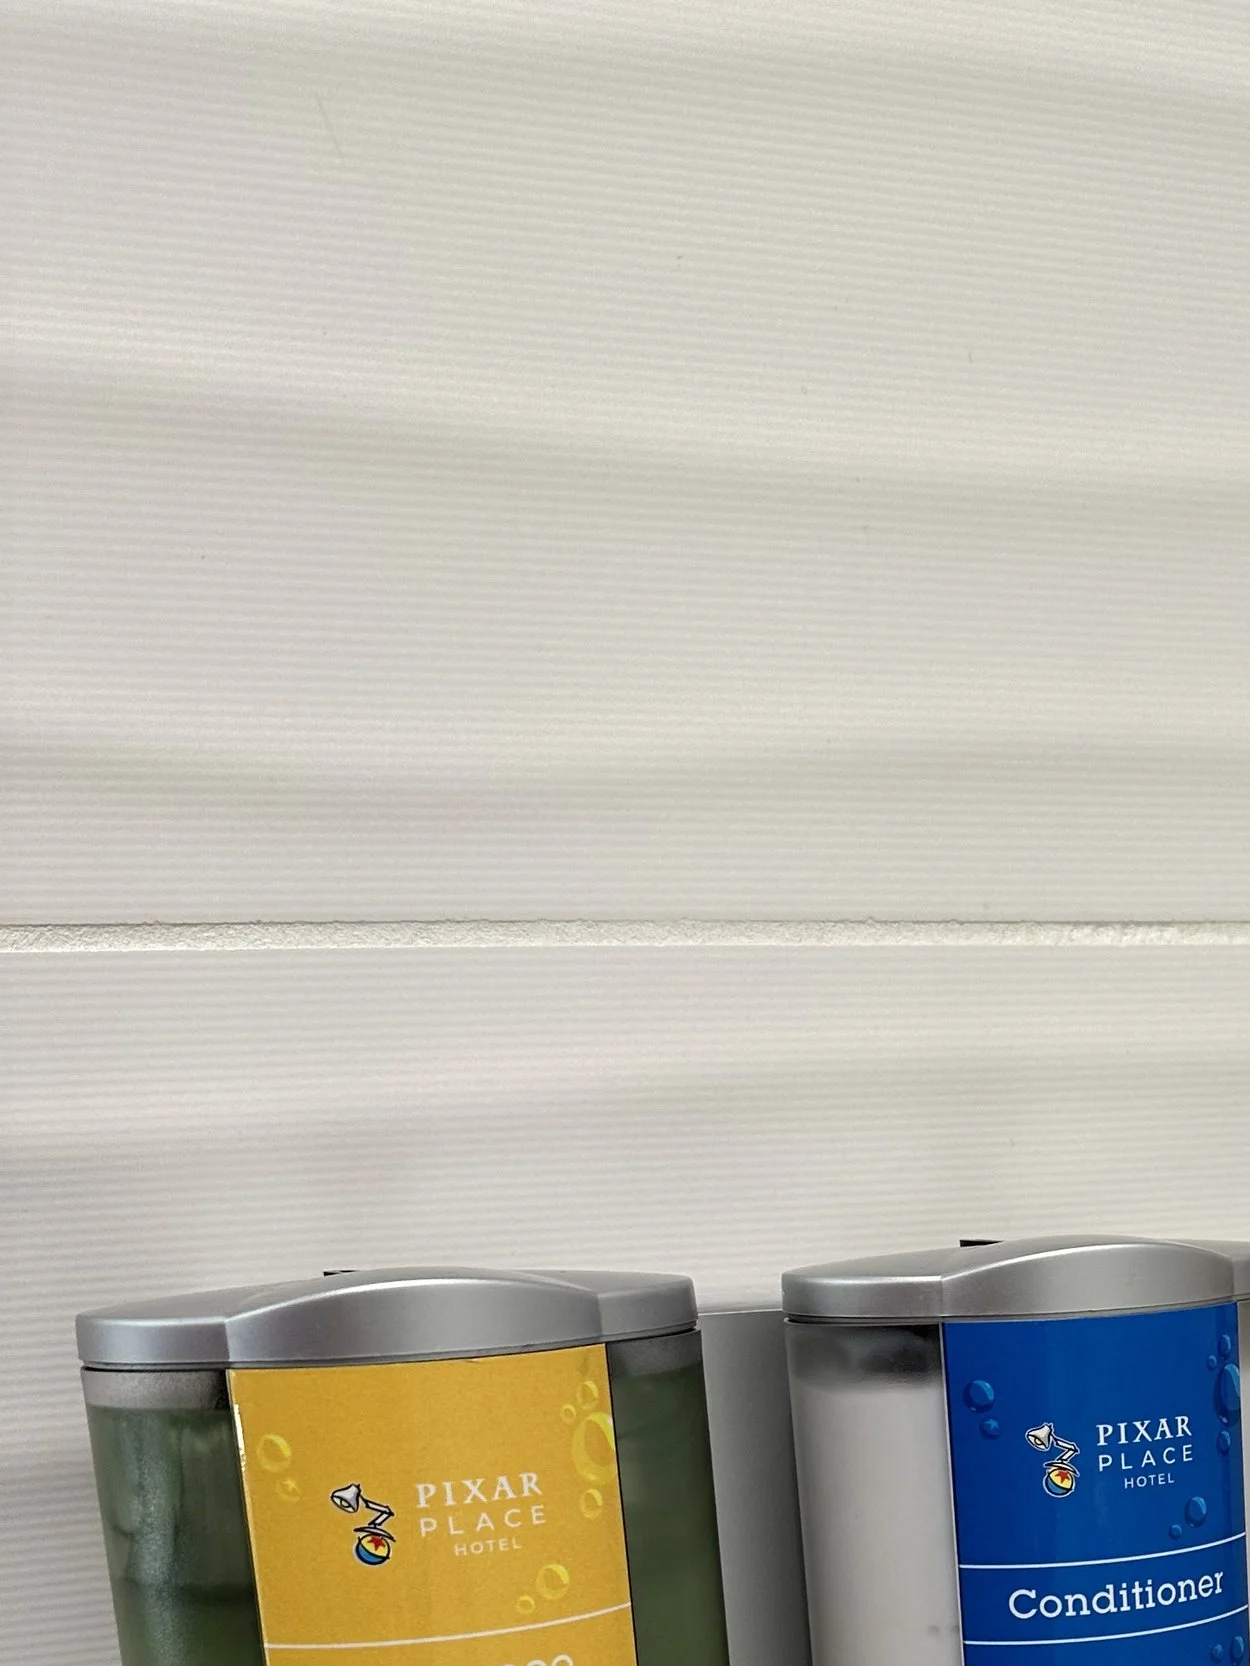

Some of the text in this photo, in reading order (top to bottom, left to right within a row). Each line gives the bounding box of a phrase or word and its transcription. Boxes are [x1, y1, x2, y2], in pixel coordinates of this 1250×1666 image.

[1097, 1415, 1193, 1446] PIXAR
[1099, 1444, 1193, 1471] PLACE
[416, 1472, 543, 1508] PIXAR
[1124, 1473, 1175, 1489] HOTEL
[420, 1505, 546, 1537] PLACE
[454, 1538, 522, 1556] HOTEL
[1009, 1571, 1224, 1619] Conditioner
